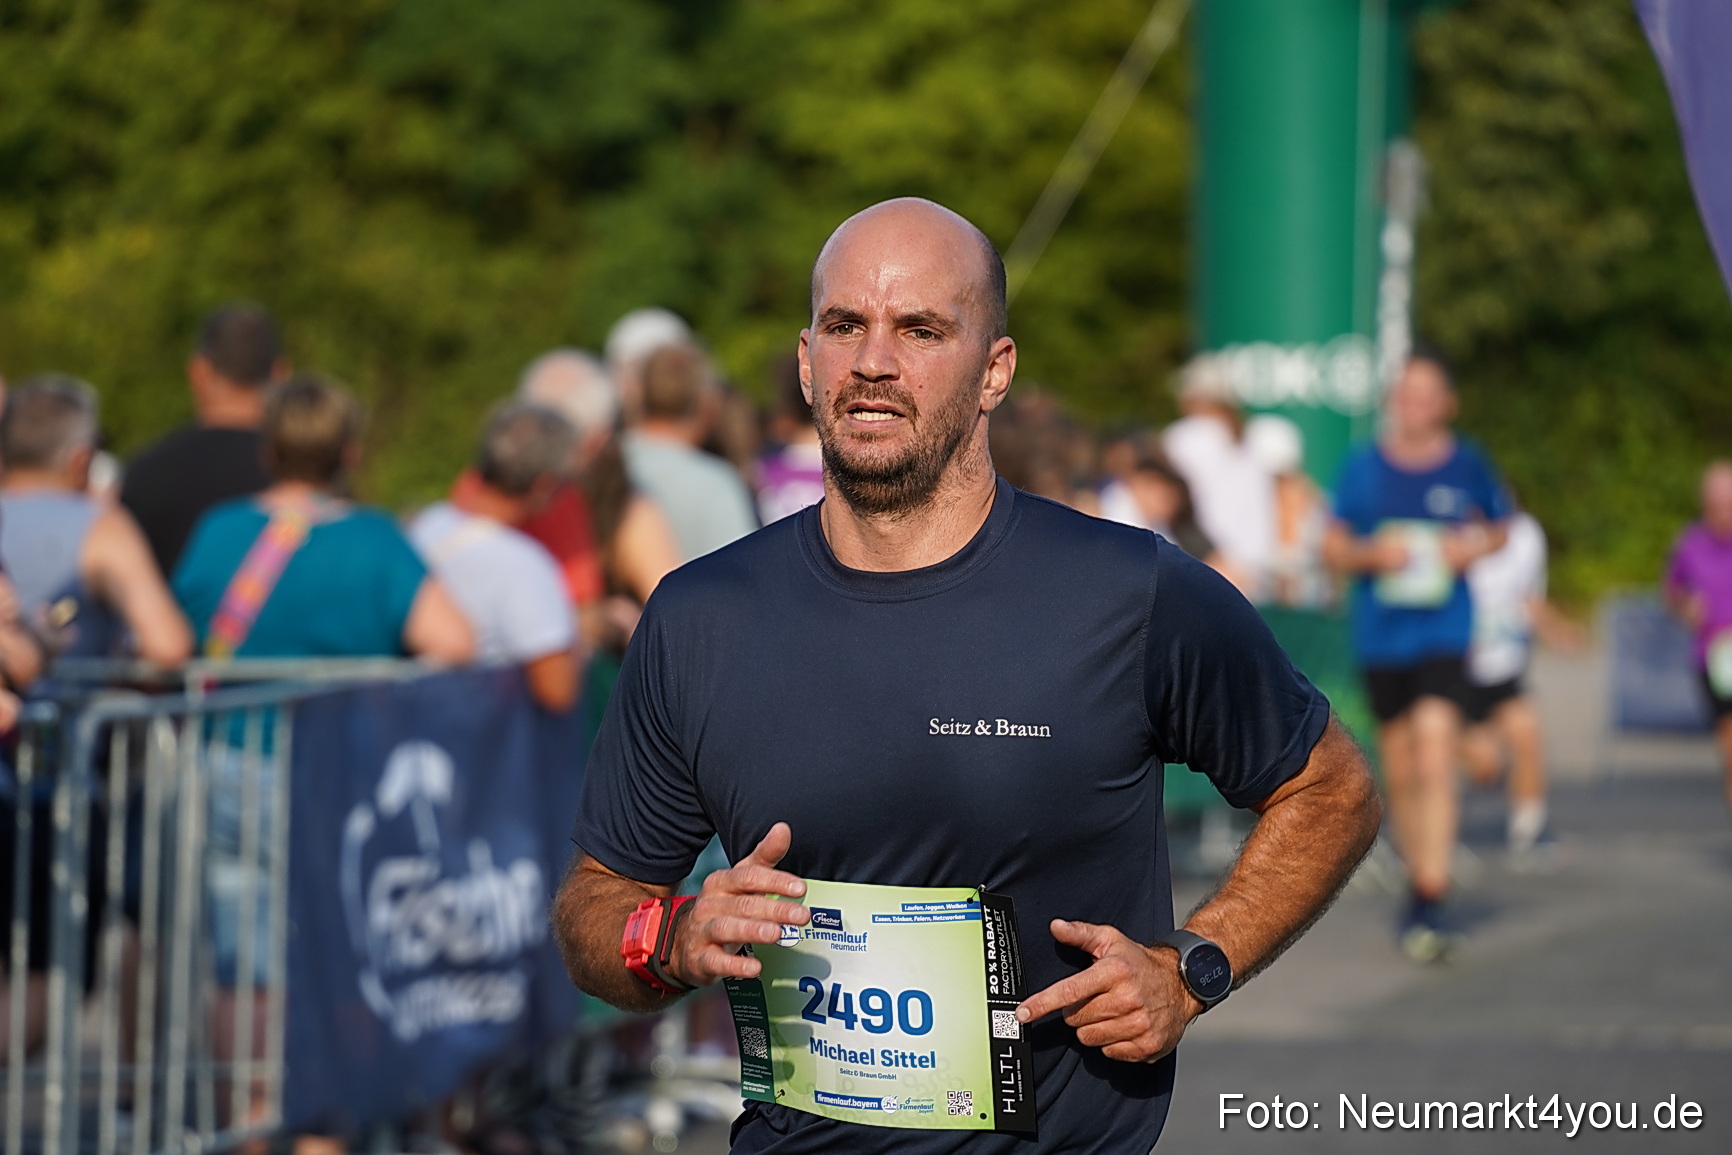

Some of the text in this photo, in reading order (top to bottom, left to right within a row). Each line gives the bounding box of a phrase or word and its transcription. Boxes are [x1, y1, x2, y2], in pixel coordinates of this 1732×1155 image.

[929, 718, 1052, 738] Seitz & Braun
[804, 928, 868, 944] Firmenlauf
[993, 909, 1006, 948] OUTLET
[830, 942, 867, 952] neumarkt
[983, 905, 999, 995] 20 % RABATT
[1000, 948, 1010, 995] FACTORY
[798, 976, 934, 1036] 2490
[809, 1036, 936, 1069] Michael Sittel
[839, 1067, 854, 1077] Seitz
[859, 1070, 878, 1079] Braun
[878, 1072, 897, 1081] GmbH
[999, 1046, 1017, 1113] HILTL
[817, 1093, 879, 1110] firmenlauf.bayern
